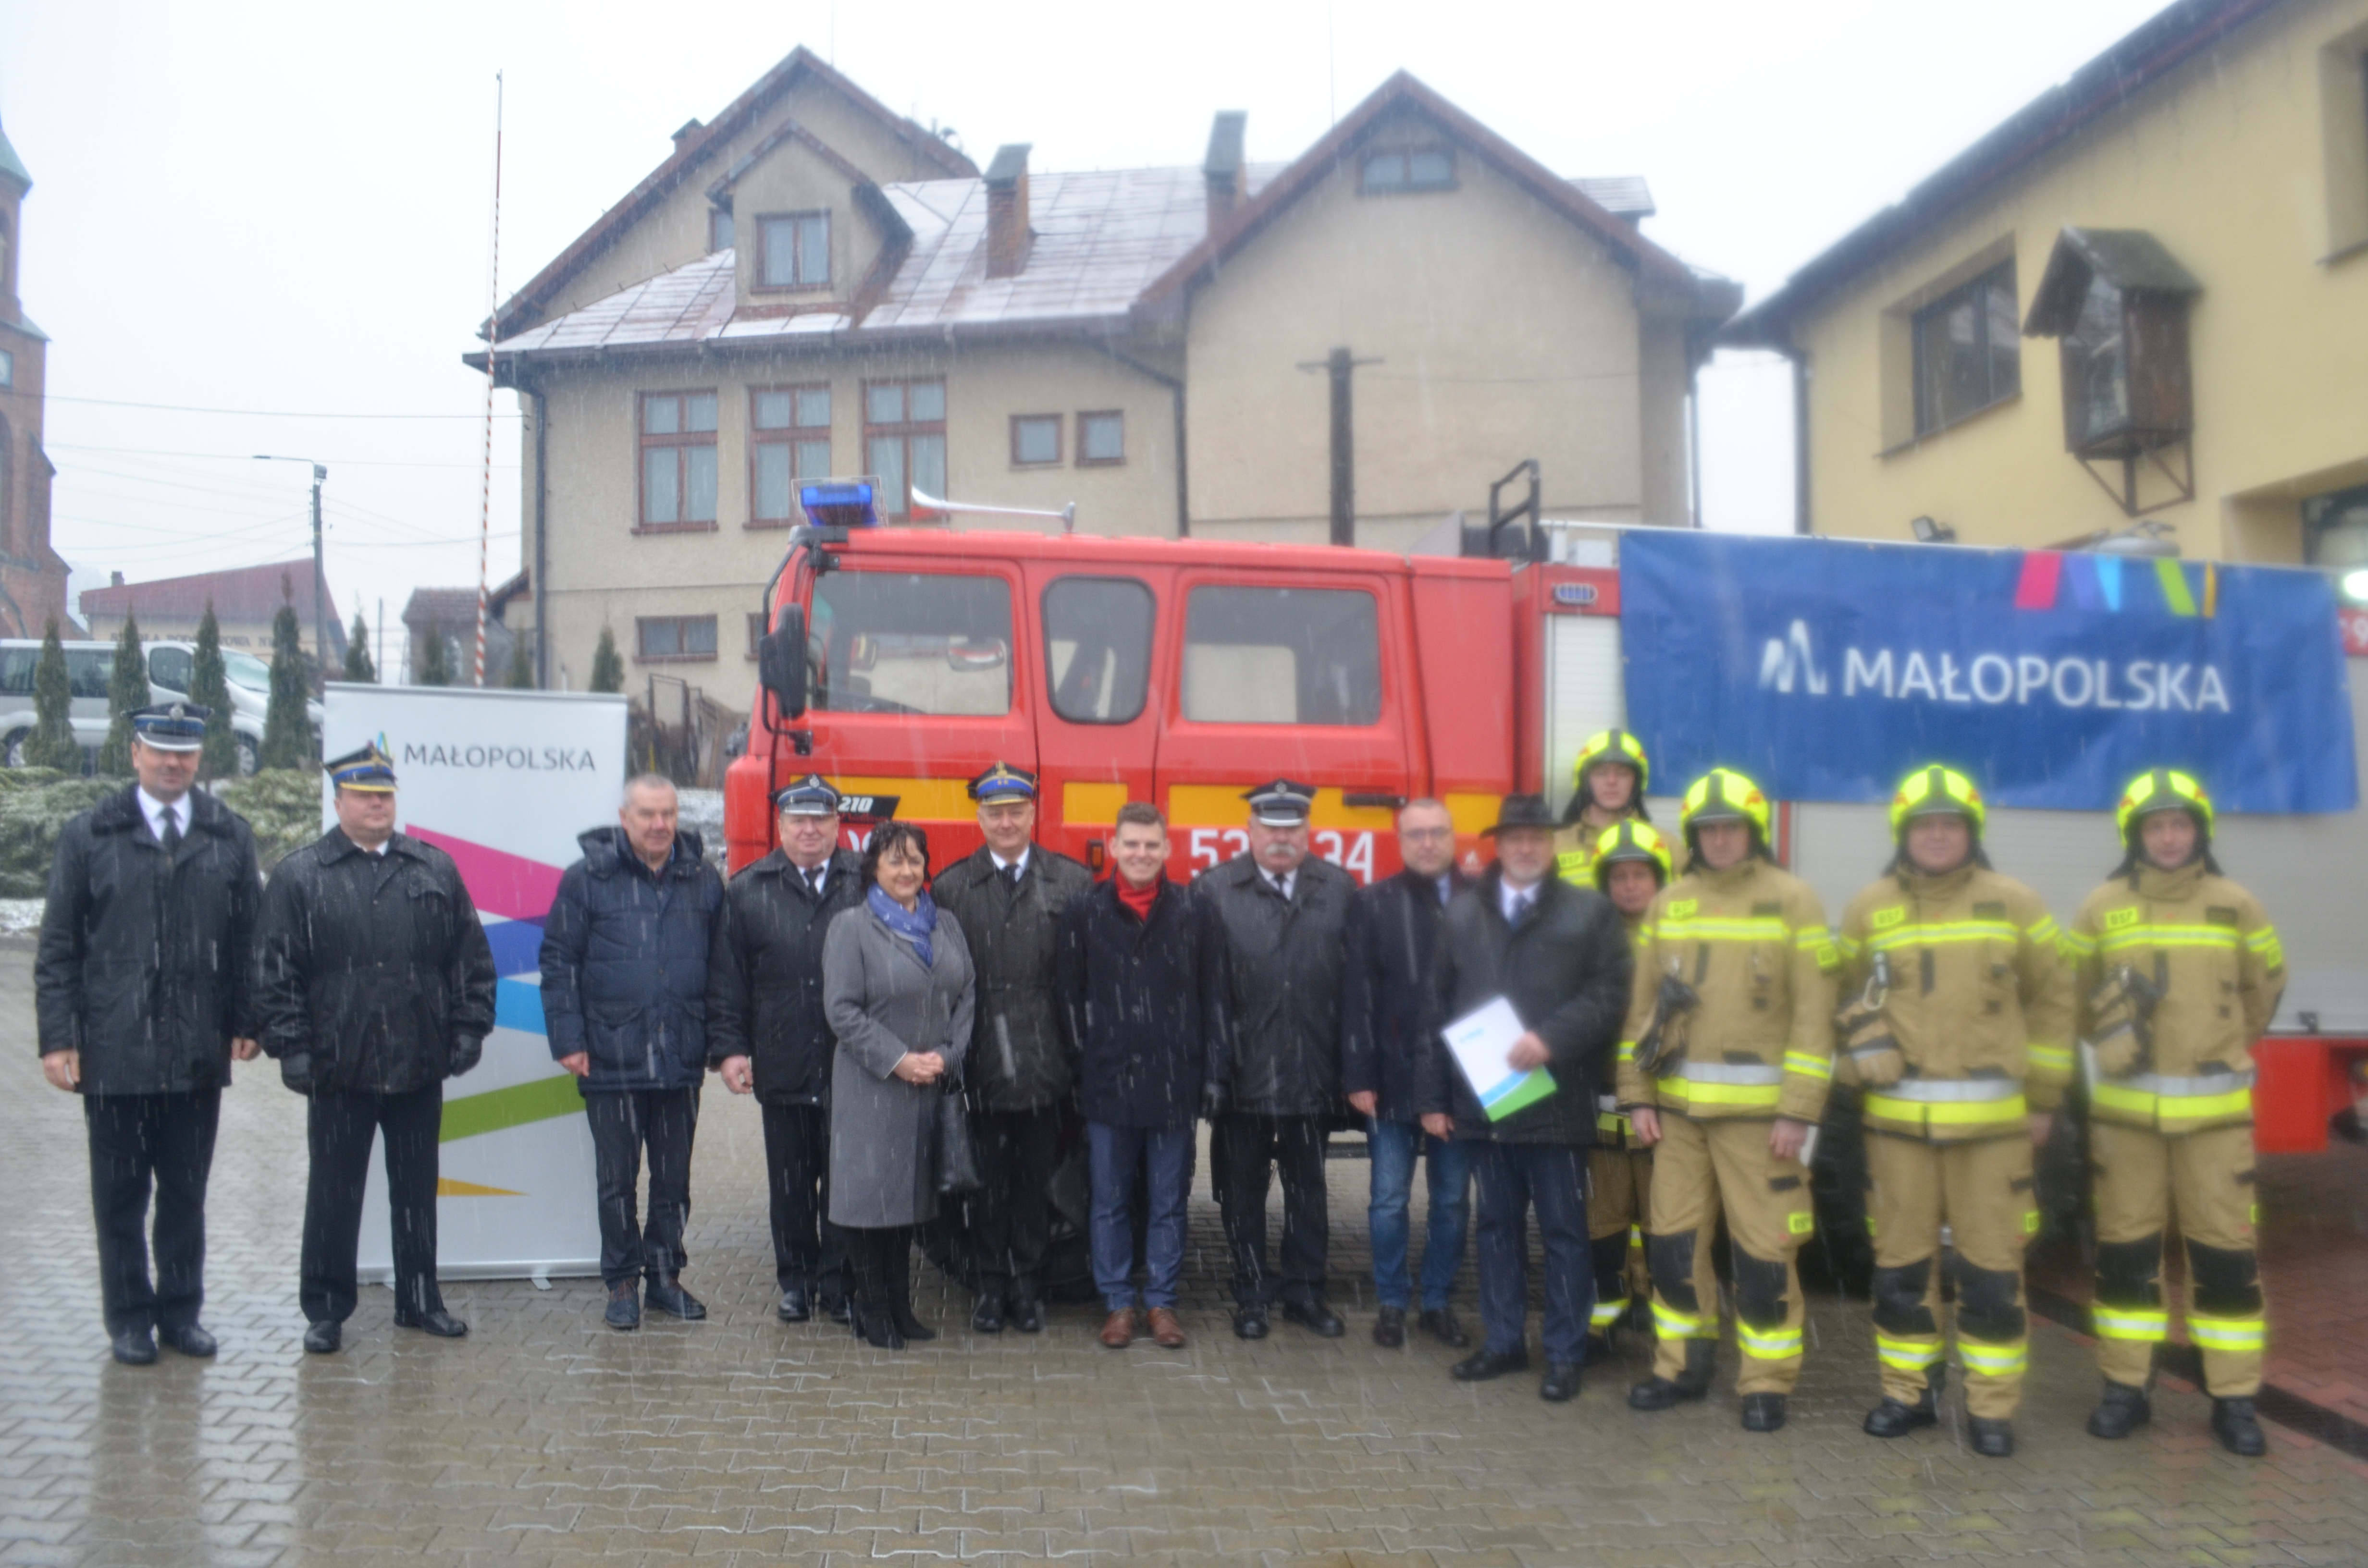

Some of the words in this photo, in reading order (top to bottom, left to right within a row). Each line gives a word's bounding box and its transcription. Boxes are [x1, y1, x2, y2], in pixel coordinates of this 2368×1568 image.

[1844, 646, 2231, 713] MAŁOPOLSKA
[404, 742, 596, 771] MAŁOPOLSKA
[838, 796, 874, 813] 210
